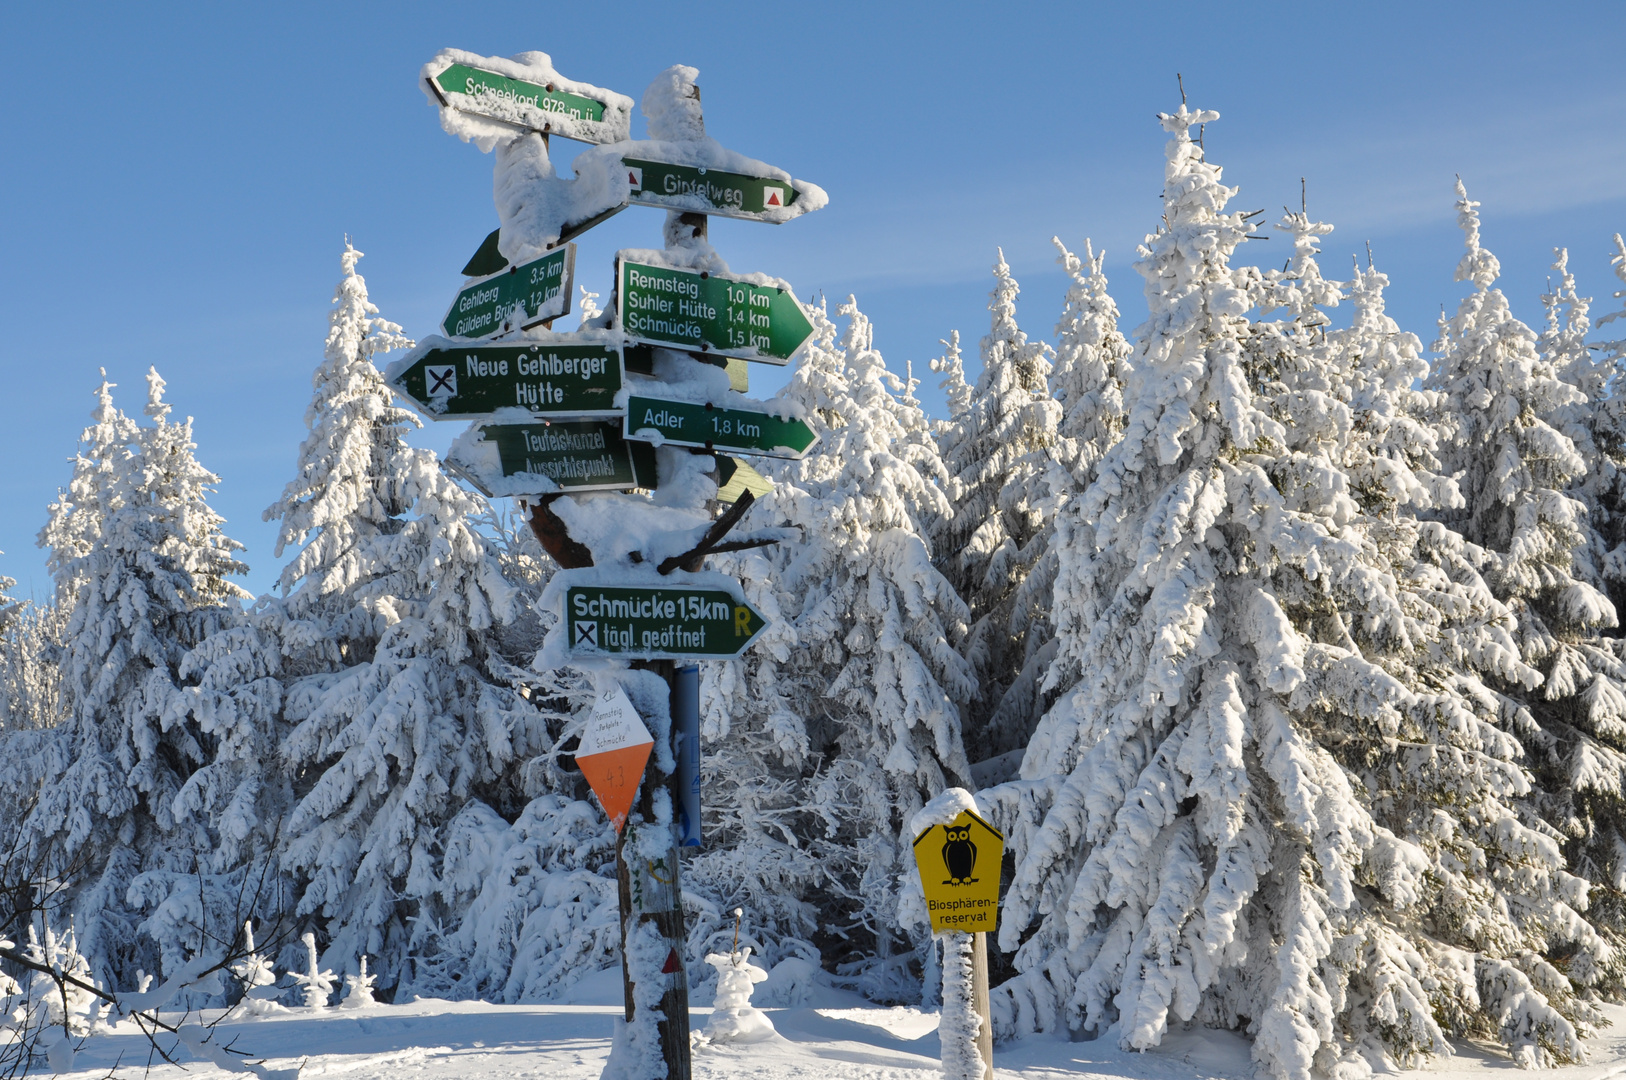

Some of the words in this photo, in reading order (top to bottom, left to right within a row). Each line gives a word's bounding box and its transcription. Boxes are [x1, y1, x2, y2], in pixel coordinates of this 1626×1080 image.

[542, 97, 566, 114] 978
[570, 107, 581, 120] m
[459, 286, 499, 313] Gehlberg
[530, 267, 545, 286] 3,5
[547, 261, 562, 278] km
[629, 269, 699, 299] Rennsteig
[726, 286, 745, 305] 1,0
[749, 290, 770, 308] km
[455, 312, 491, 336] Güldene
[530, 291, 542, 309] 1,2
[544, 285, 560, 300] km
[628, 291, 674, 314] Suhler
[679, 300, 716, 320] Hütte
[727, 307, 744, 325] 1,4
[749, 310, 770, 328] km
[628, 311, 701, 339] Schmücke
[727, 327, 745, 346] 1,5
[749, 330, 770, 348] km
[466, 355, 508, 377] Neue
[517, 353, 608, 380] Gehlberger
[516, 382, 563, 404] Hütte
[643, 408, 684, 429] Adler
[711, 416, 732, 436] 1,8
[737, 419, 760, 438] km
[521, 427, 606, 452] Teufelskanzel
[525, 453, 615, 482] Aussichtspunkt
[573, 593, 676, 619] Schmücke
[734, 606, 752, 637] R
[603, 623, 637, 649] tägl.
[642, 624, 706, 649] geöffnet
[929, 897, 996, 911] Biosphären-
[939, 911, 987, 924] reservat
